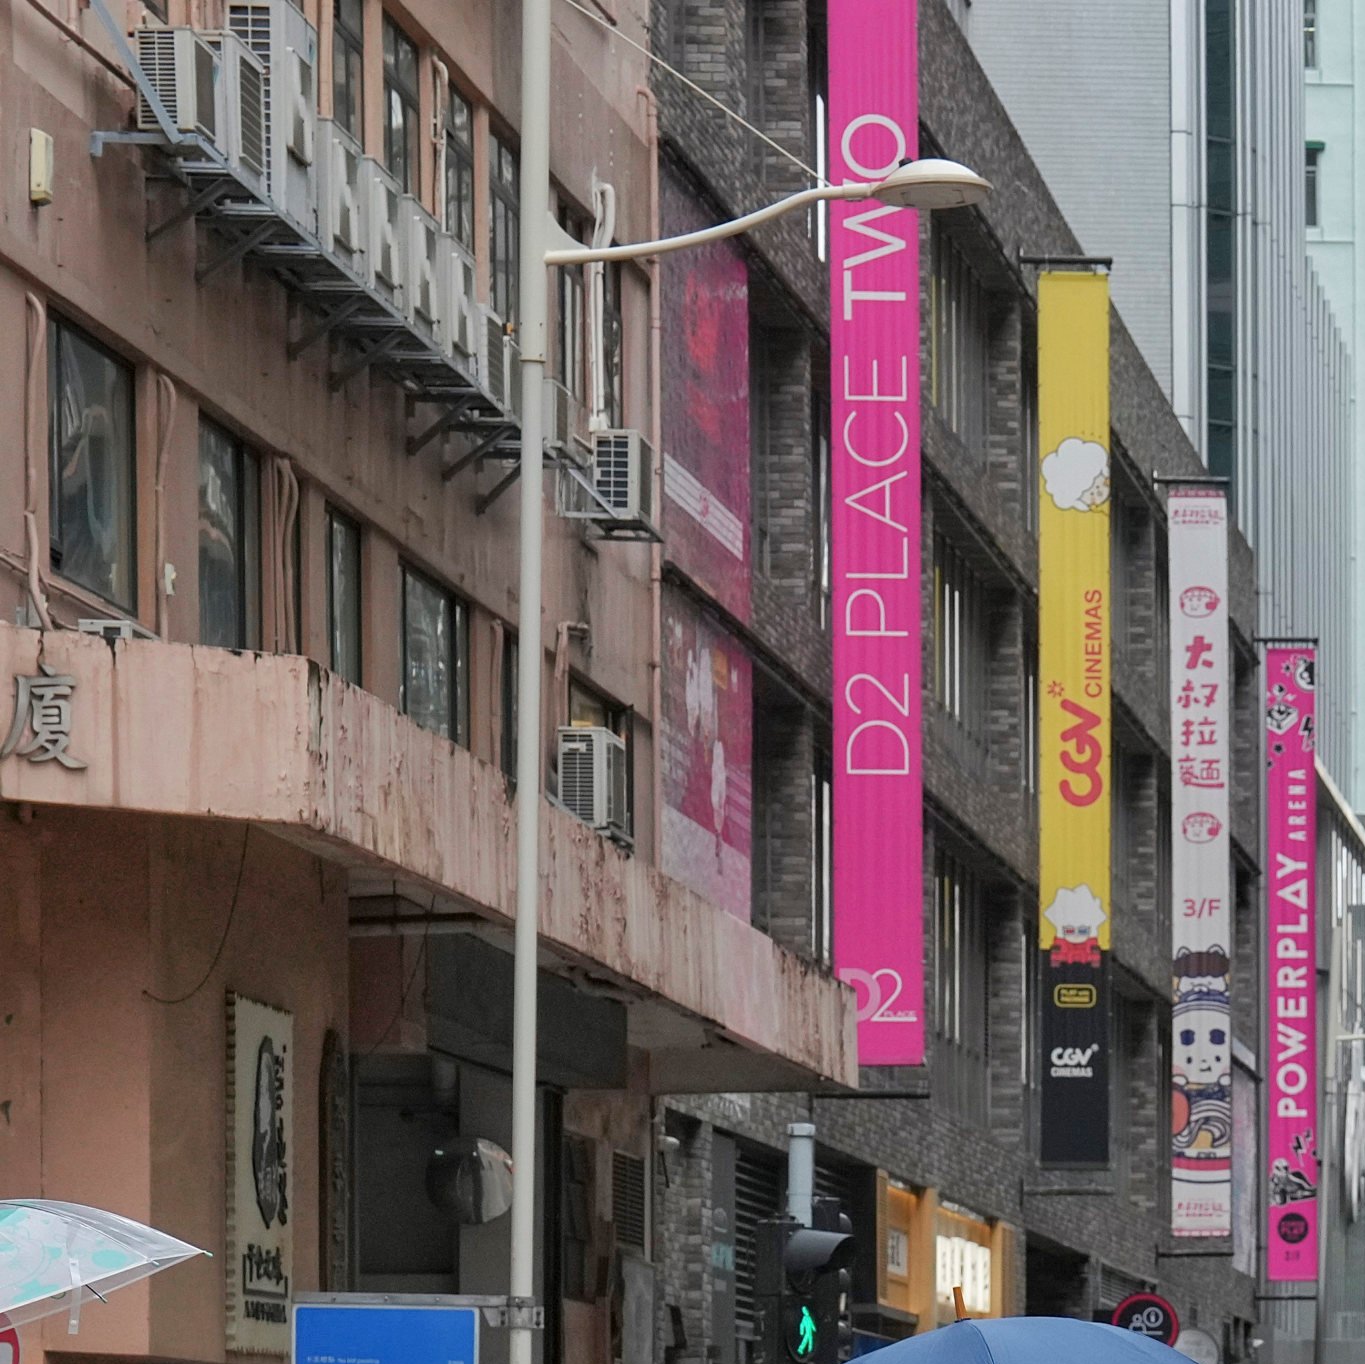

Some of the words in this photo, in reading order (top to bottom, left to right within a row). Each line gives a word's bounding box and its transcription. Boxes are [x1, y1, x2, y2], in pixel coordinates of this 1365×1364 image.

[841, 113, 907, 321] TWO
[843, 354, 910, 638] PLACE
[1083, 588, 1103, 698] CINEMAS
[0, 662, 88, 771] 廈
[844, 673, 910, 776] D2
[1058, 698, 1103, 808] CGV
[1287, 768, 1307, 841] ARENA
[1182, 897, 1222, 919] 3/F
[1275, 852, 1308, 1118] POWERPLAY
[1050, 1046, 1093, 1066] CGV
